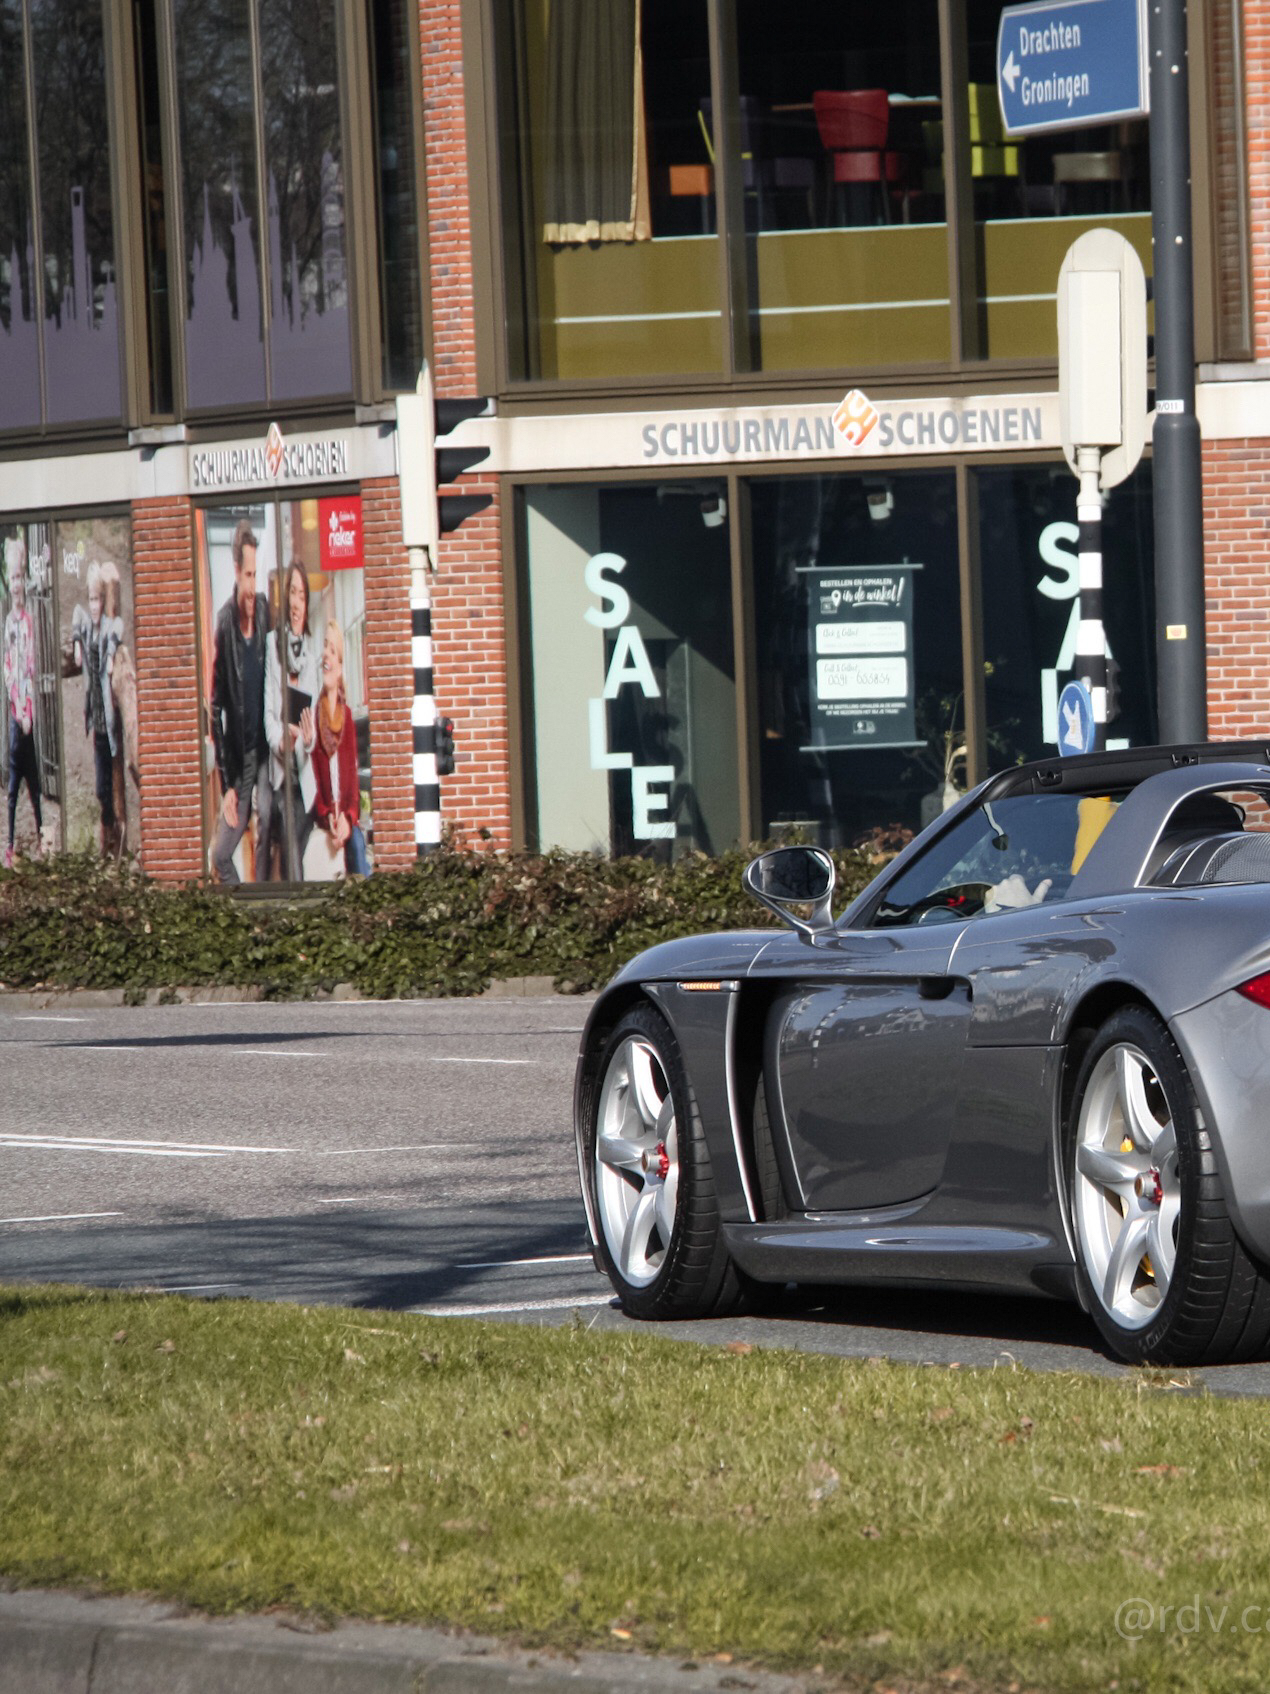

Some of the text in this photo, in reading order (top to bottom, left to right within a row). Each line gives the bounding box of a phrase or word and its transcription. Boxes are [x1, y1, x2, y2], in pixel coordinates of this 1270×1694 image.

[1020, 22, 1081, 57] Drachten
[1021, 72, 1090, 108] Groningen
[641, 407, 1043, 458] SCHUURMAN SCHOENEN
[193, 439, 347, 487] SCHUURMAN SCHOENEN
[584, 552, 676, 840] SALE
